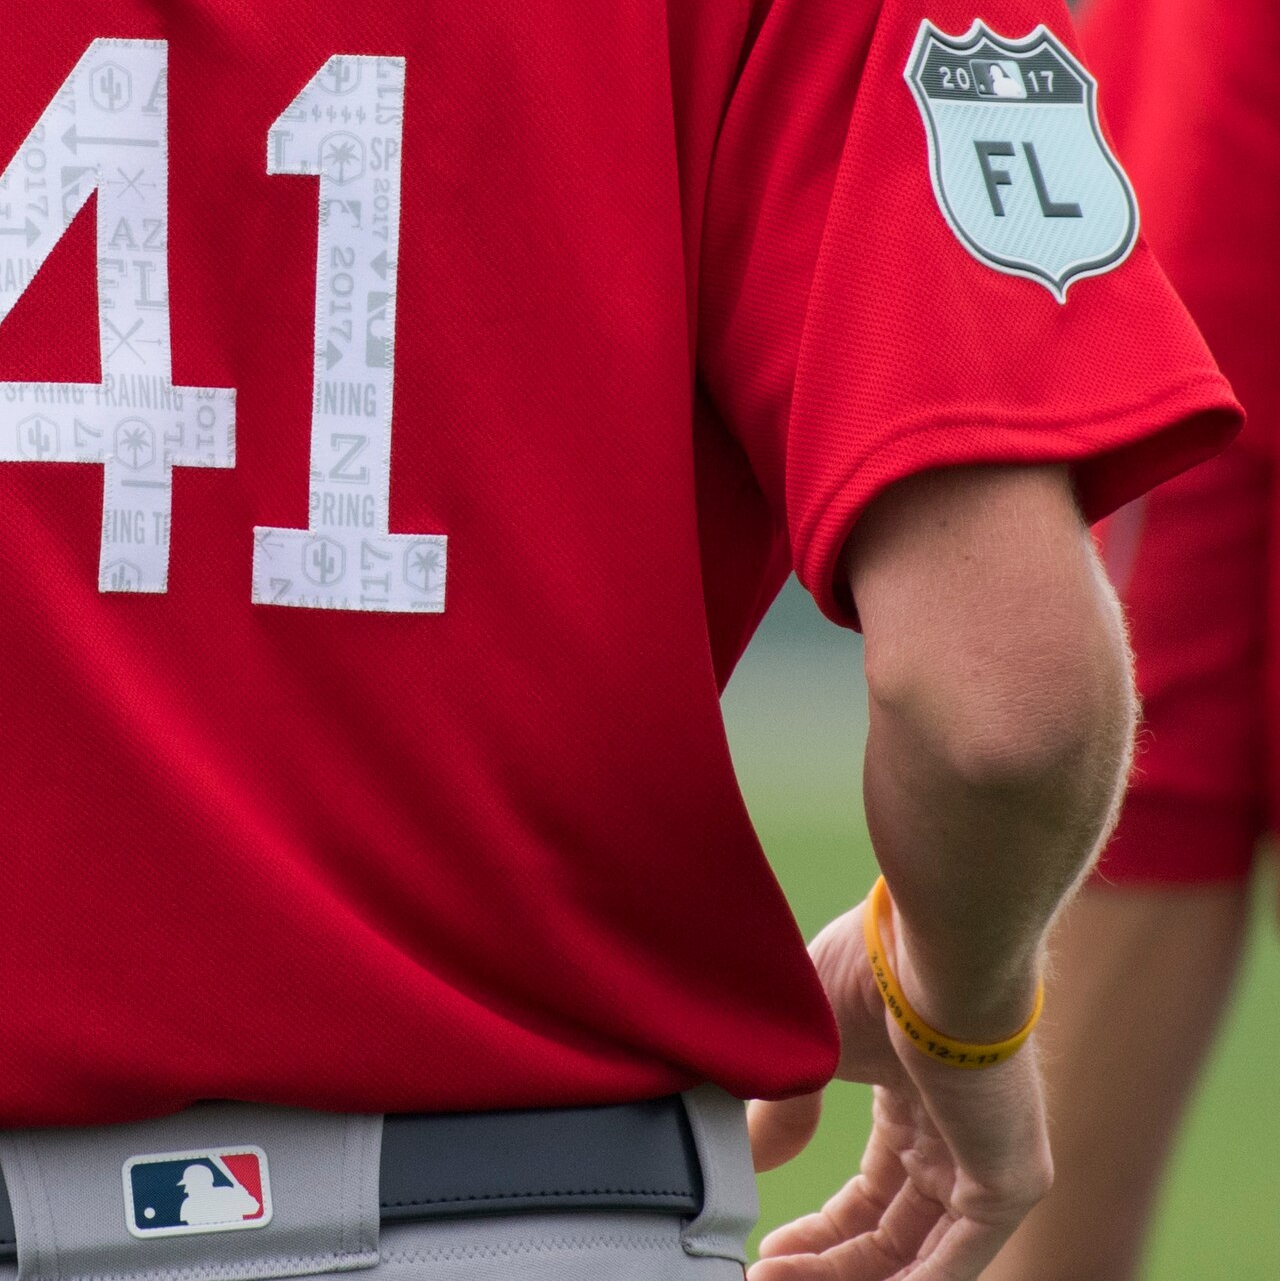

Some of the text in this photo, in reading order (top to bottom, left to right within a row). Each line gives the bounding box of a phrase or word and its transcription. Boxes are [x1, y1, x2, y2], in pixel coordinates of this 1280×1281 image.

[939, 65, 1054, 93] 20 17
[973, 140, 1083, 218] FL
[327, 245, 357, 345] 2017
